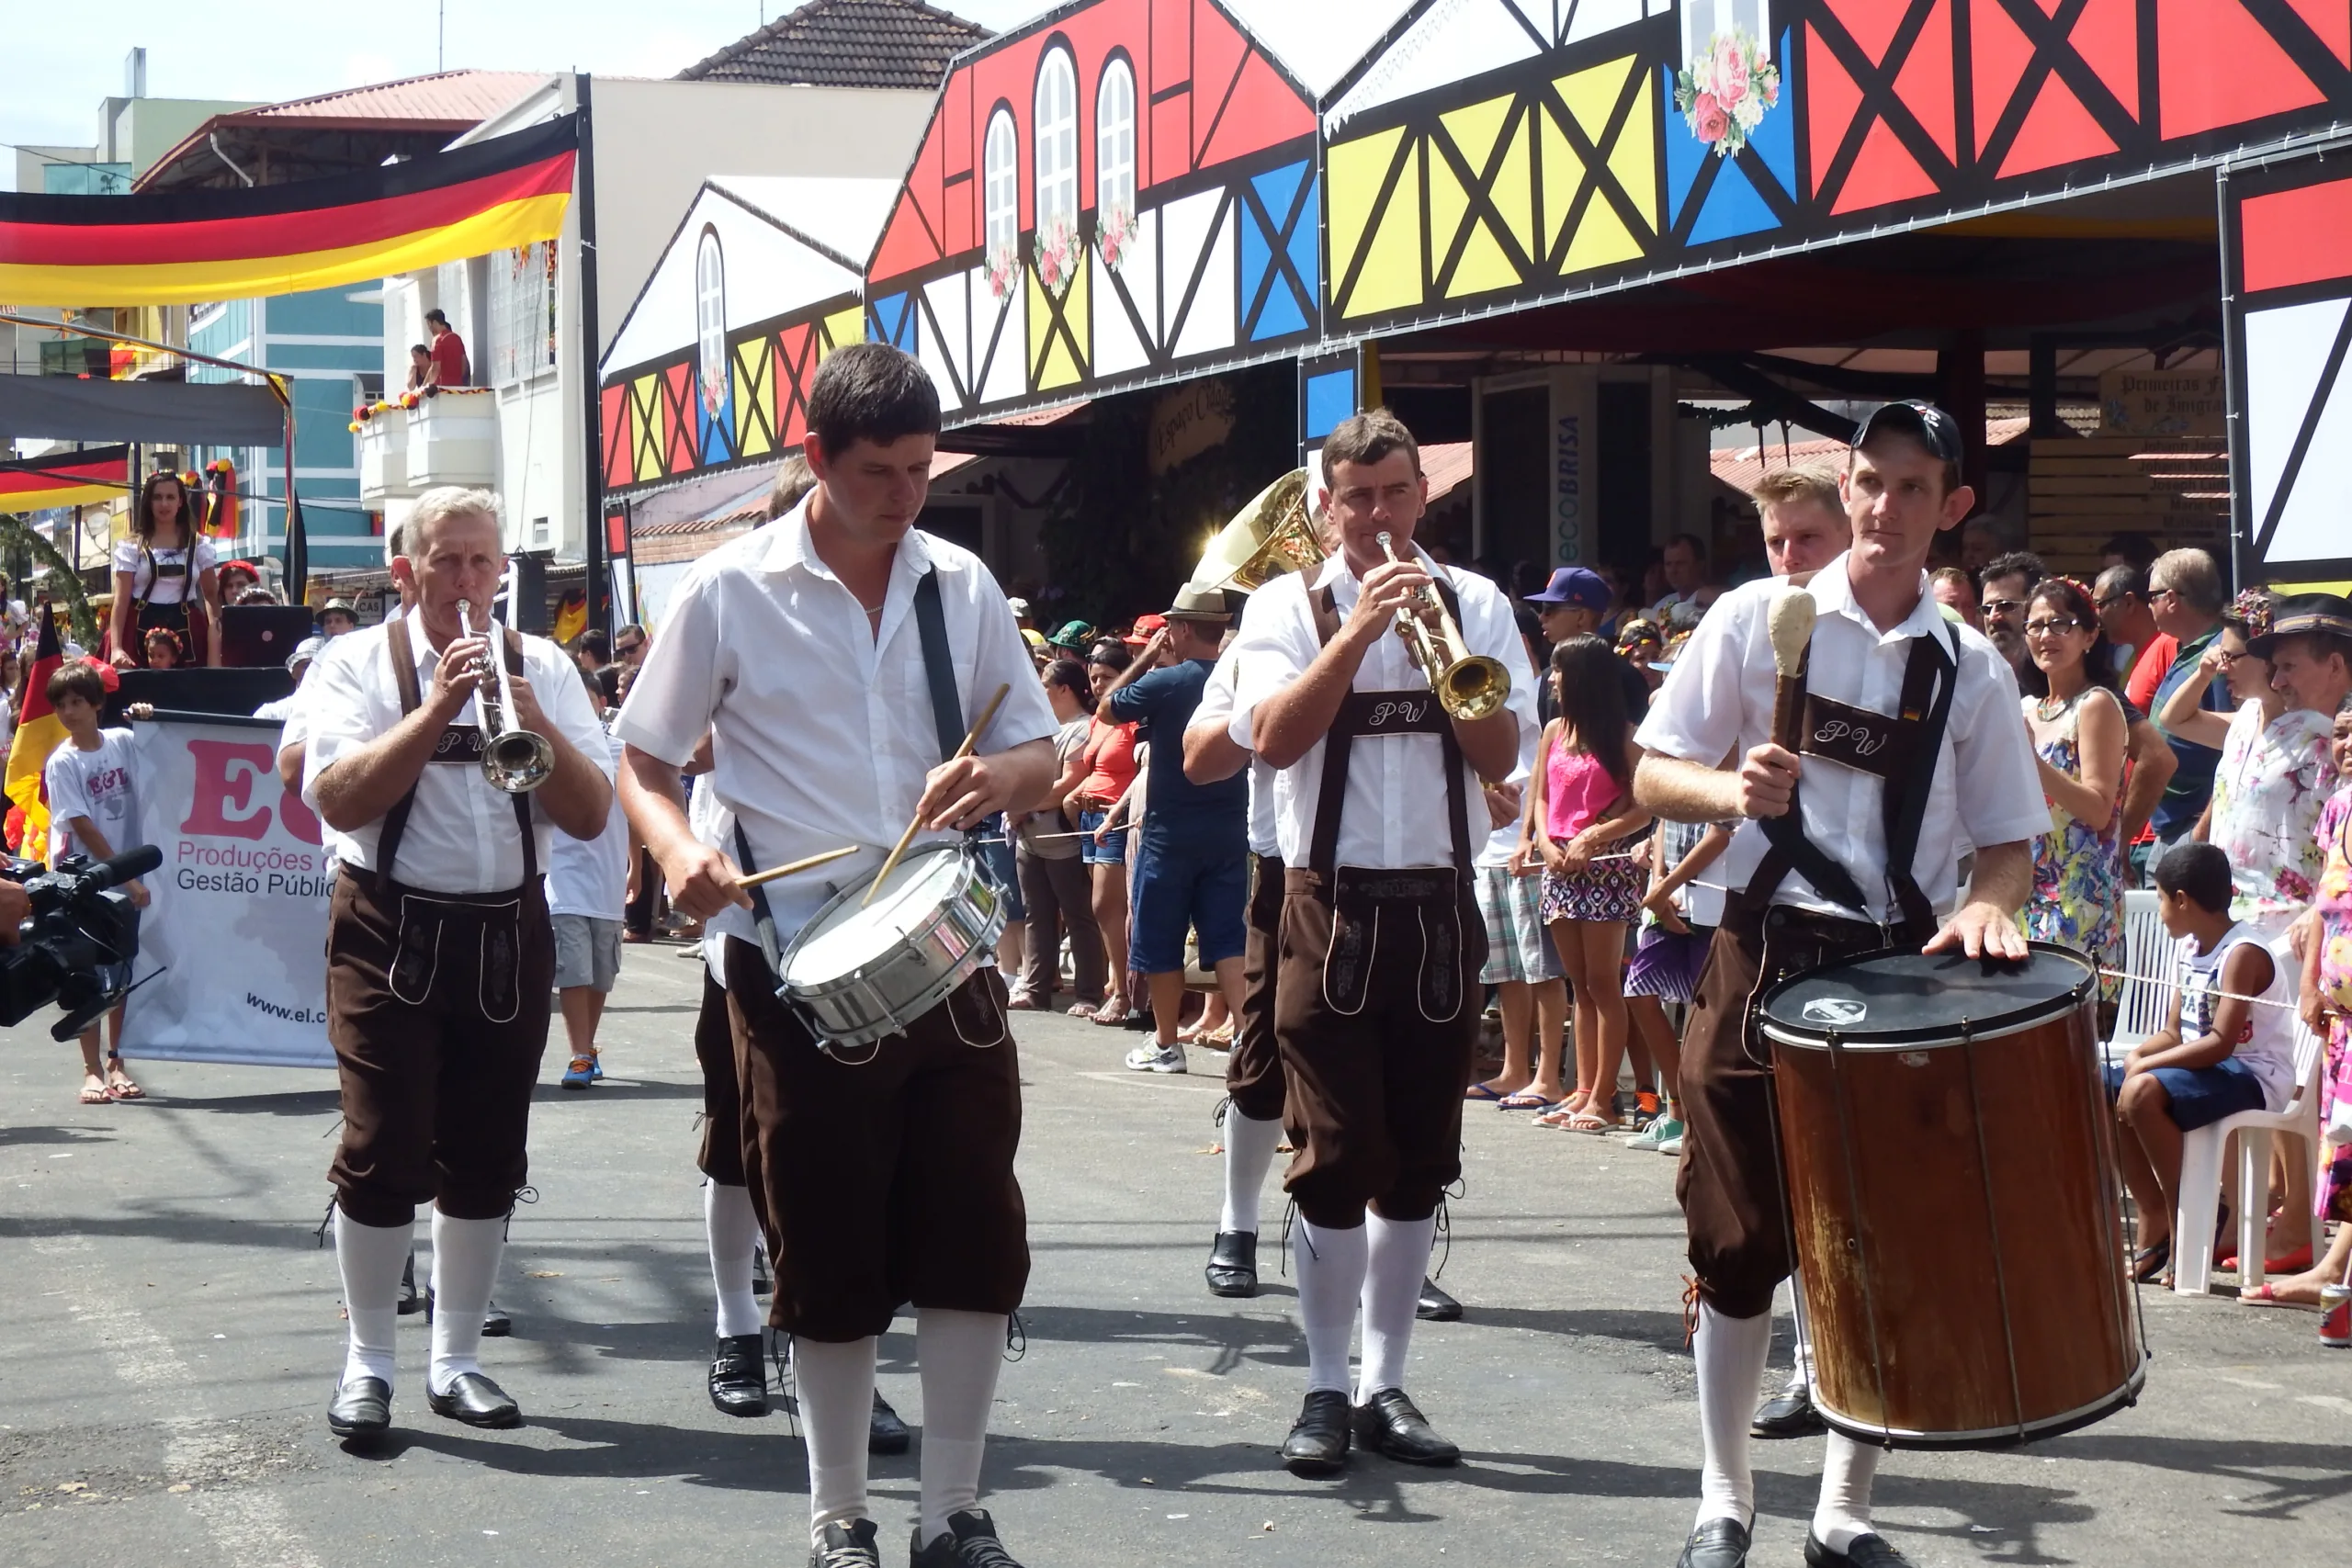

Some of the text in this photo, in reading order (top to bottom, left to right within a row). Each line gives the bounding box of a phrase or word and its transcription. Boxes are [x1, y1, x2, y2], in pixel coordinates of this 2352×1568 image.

[2120, 375, 2200, 395] Primeiras
[2144, 396, 2160, 412] de
[177, 840, 312, 874] Produções
[177, 868, 259, 894] Gestão
